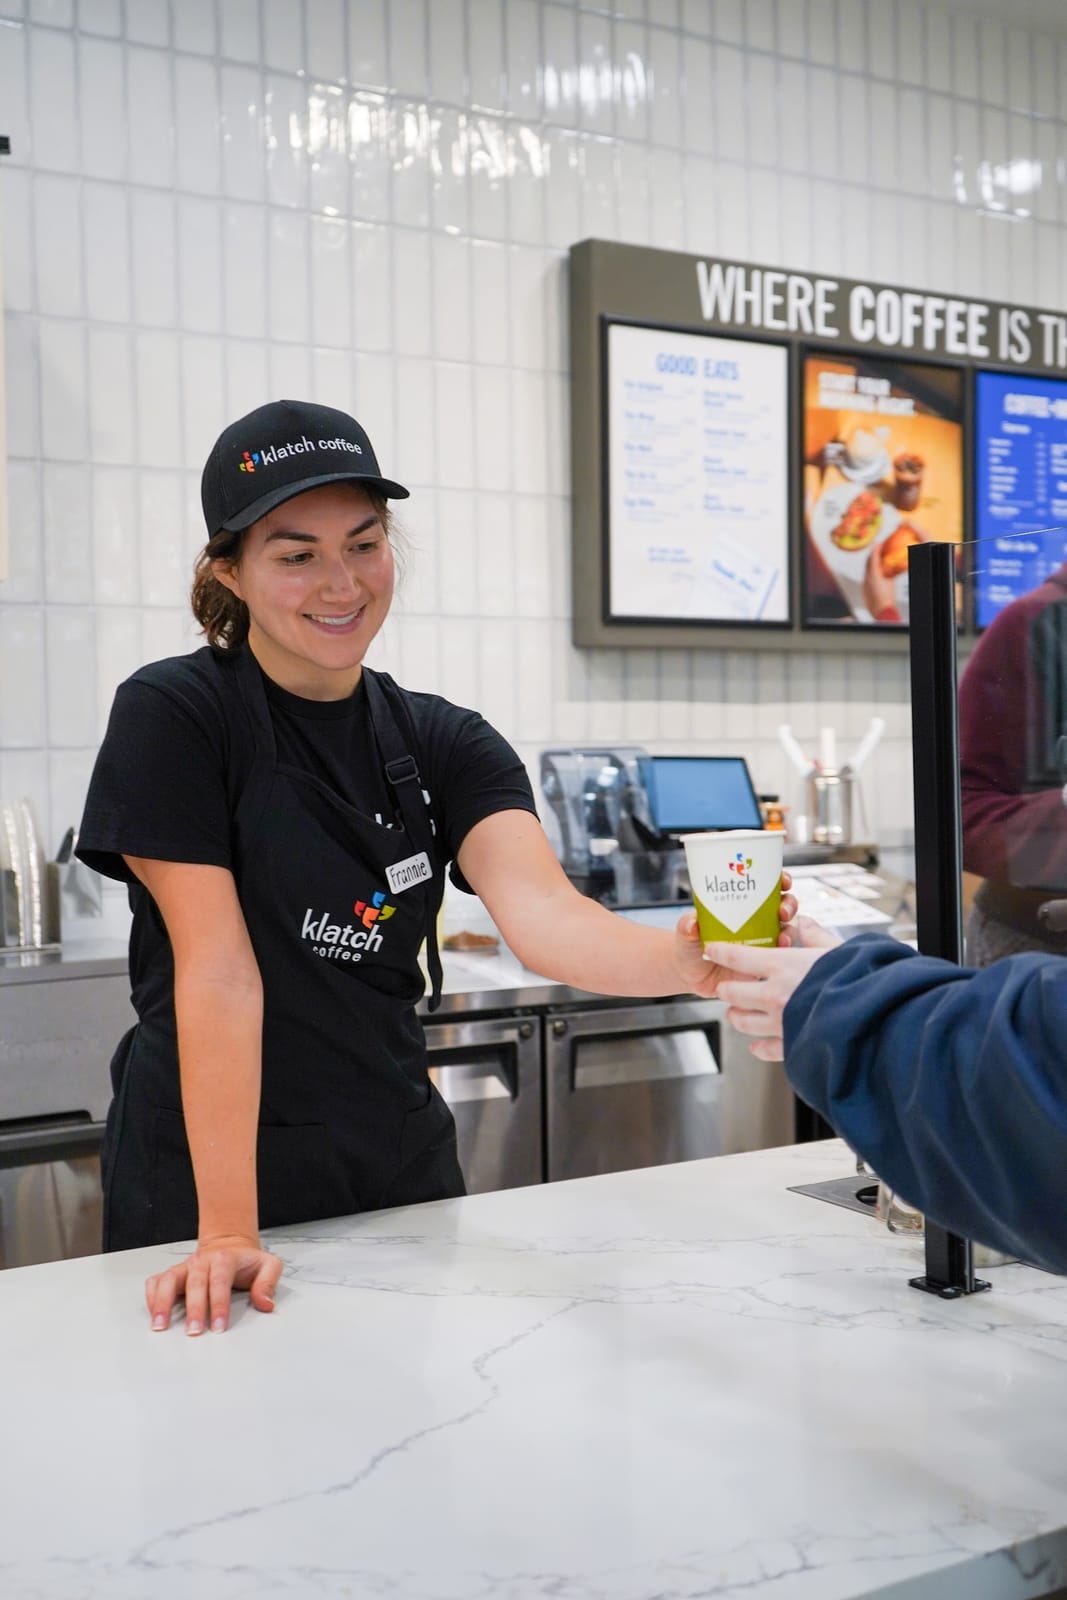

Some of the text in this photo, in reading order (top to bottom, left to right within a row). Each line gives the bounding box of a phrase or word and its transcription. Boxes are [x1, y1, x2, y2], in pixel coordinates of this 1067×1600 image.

[696, 261, 840, 338] WHERE
[849, 284, 990, 358] COFFEE
[1000, 308, 1031, 364] IS
[656, 352, 739, 381] GOOD EATS
[261, 436, 362, 465] klatch coffee
[389, 859, 427, 888] Frannie
[705, 874, 756, 893] klatch
[301, 908, 384, 952] klatch
[312, 945, 362, 962] coffee
